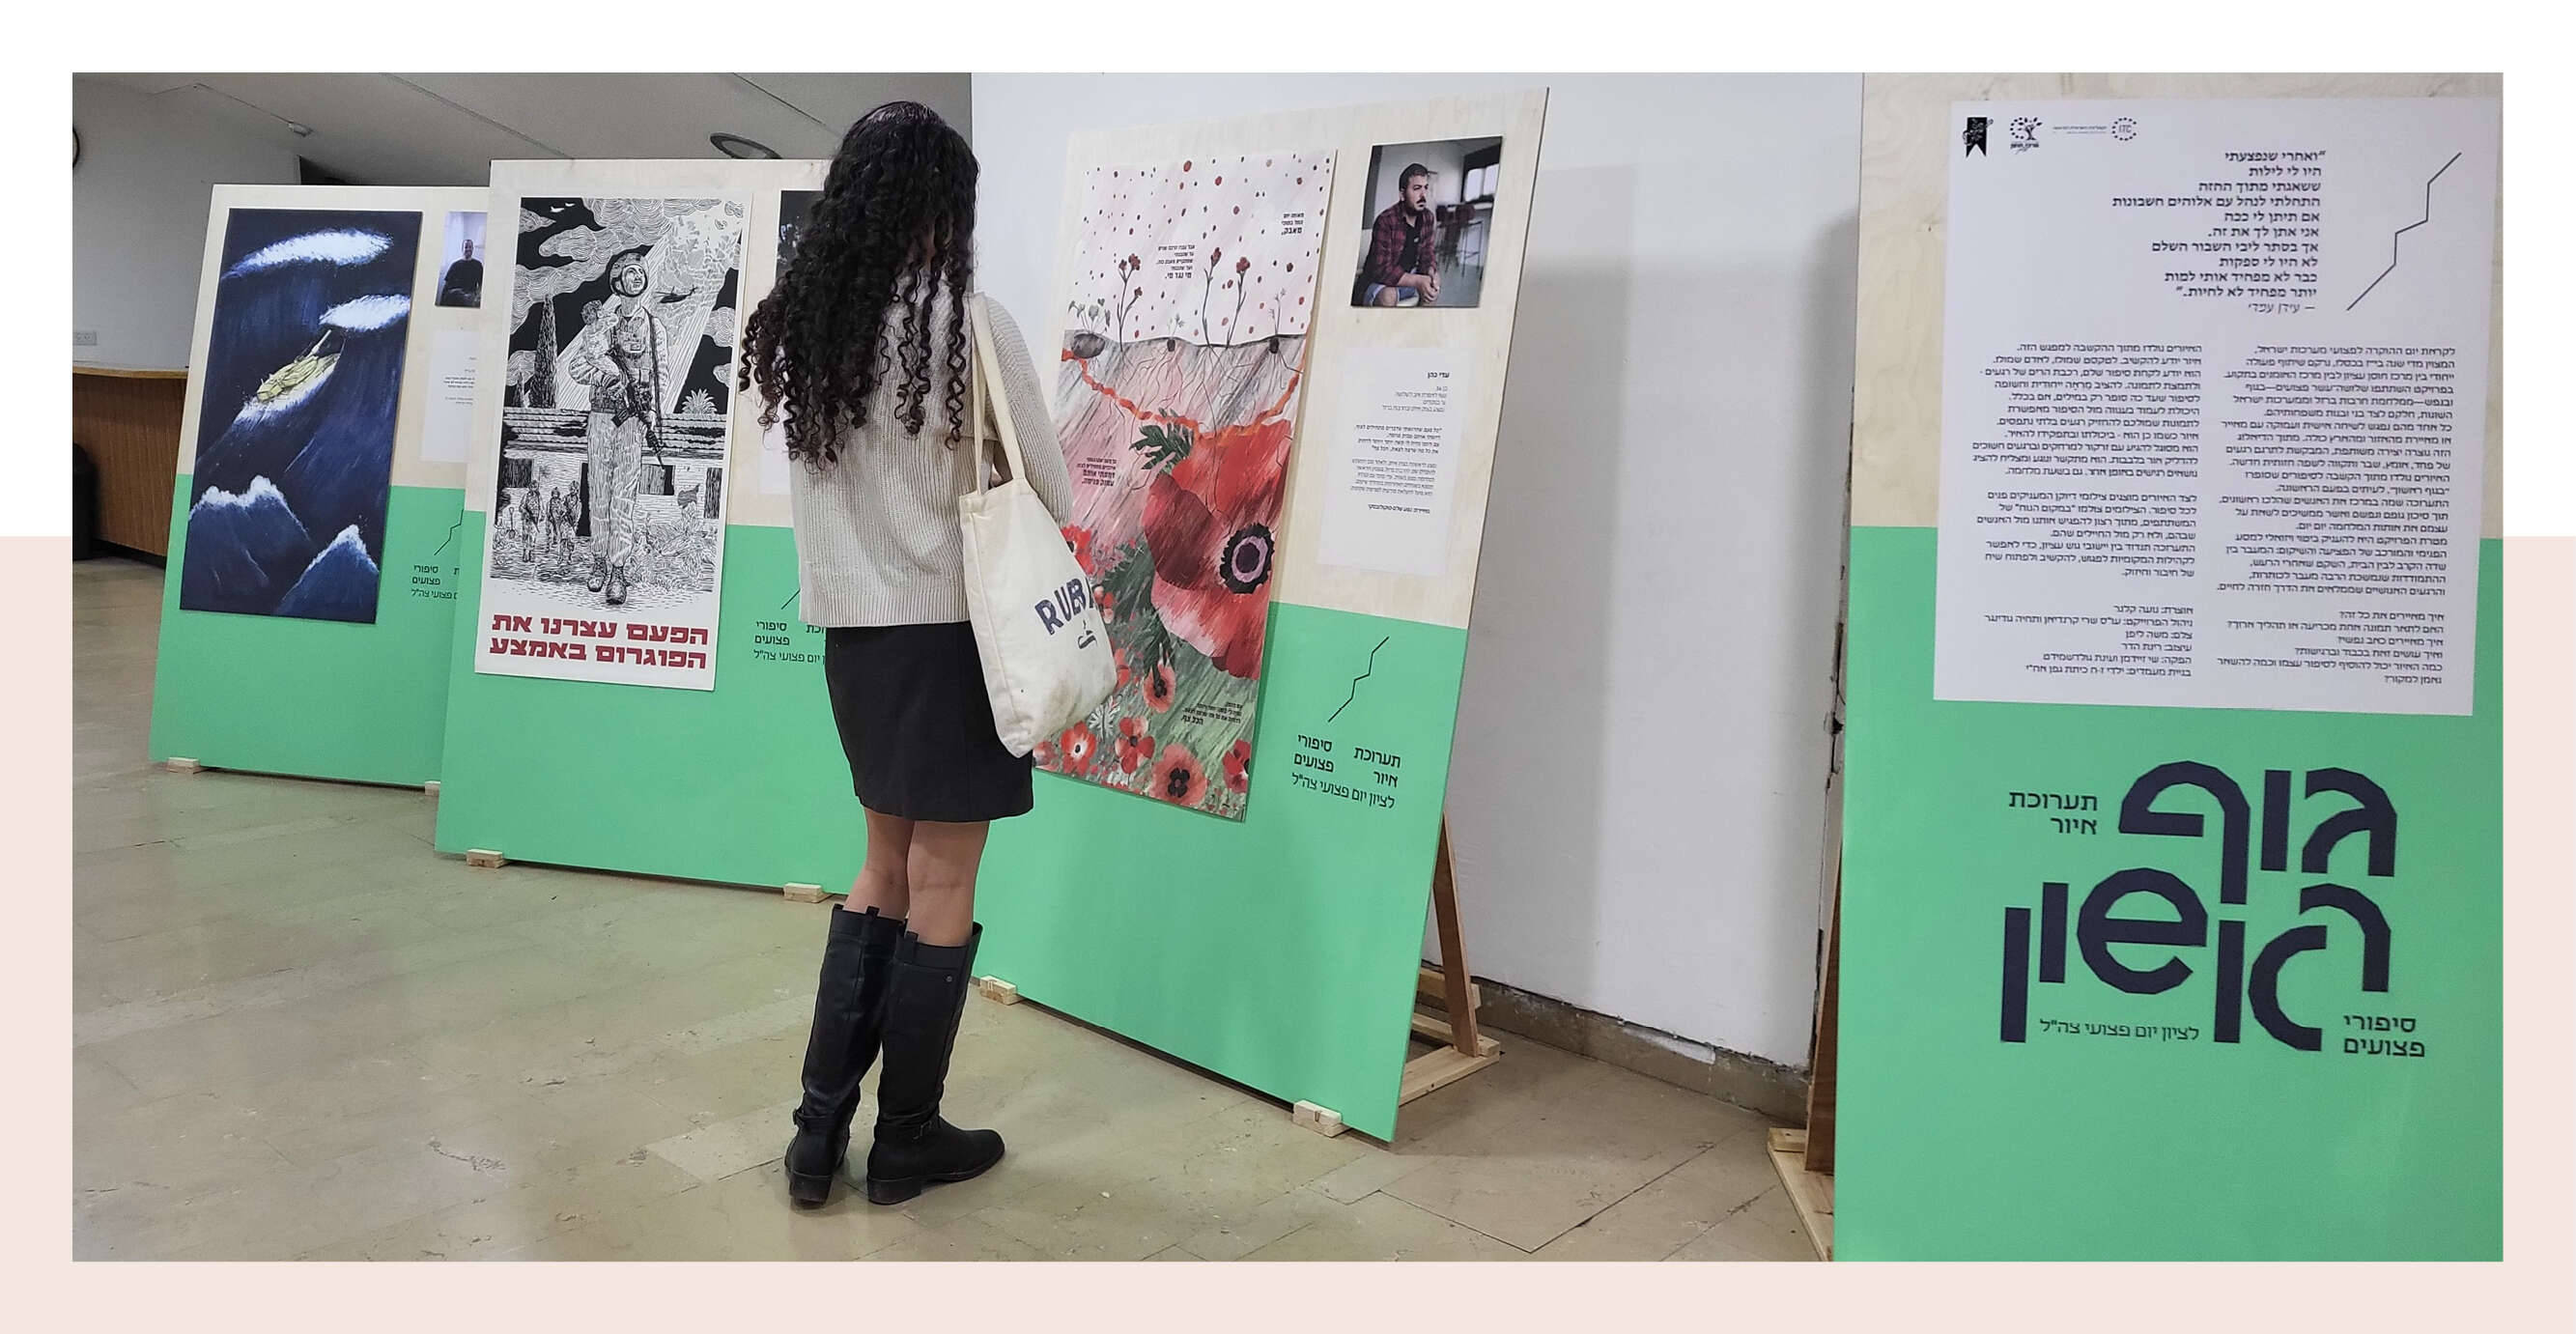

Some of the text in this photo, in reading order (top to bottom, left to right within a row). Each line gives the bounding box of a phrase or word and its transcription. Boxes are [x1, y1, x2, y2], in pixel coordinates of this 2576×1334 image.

[2224, 152, 2279, 162] שנפצעתי
[2248, 165, 2321, 176] היו לי לילות
[2198, 183, 2321, 193] ששאגתי מתוך החזה
[2111, 195, 2320, 207] התחלתי לנהל עם אלוהים חשבונות
[2224, 211, 2320, 223] אם תיתן לי ככה
[2207, 226, 2319, 239] אני אתן לך את זה.
[2151, 241, 2318, 254] אך בסתר ליבי השבור השלם
[2219, 256, 2318, 269] לא היו לי ספקות
[2164, 270, 2317, 282] כבר לא מפחיד אותי למות
[2226, 286, 2244, 297] לא
[2247, 288, 2286, 298] מפחיד
[2289, 289, 2316, 298] יותר
[413, 564, 439, 574] סיפורי
[411, 576, 441, 585] פצועים
[1034, 578, 1094, 636] RUB
[492, 614, 708, 645] הפעם עצרנו את
[756, 621, 787, 632] סיפורי
[754, 635, 790, 646] פצועים
[490, 638, 707, 669] הפוגרום באמצע
[779, 652, 805, 663] פצועי
[807, 654, 820, 664] יום
[1297, 734, 1333, 752] סיפורי
[1293, 752, 1335, 773] פצועים
[1353, 747, 1401, 768] תערוכת
[1373, 771, 1399, 788] איור
[1320, 781, 1349, 799] פצועי
[1351, 788, 1368, 802] יום
[1369, 792, 1395, 809] לציון
[2009, 791, 2097, 811] תערוכת
[2050, 817, 2097, 836] איור
[2118, 760, 2397, 905] גוף
[2000, 867, 2392, 1052] ראשון
[2040, 1018, 2199, 1042] לציון יום פצועי צה"ל
[2343, 1015, 2416, 1033] סיפורי
[2344, 1037, 2425, 1058] פצועים
